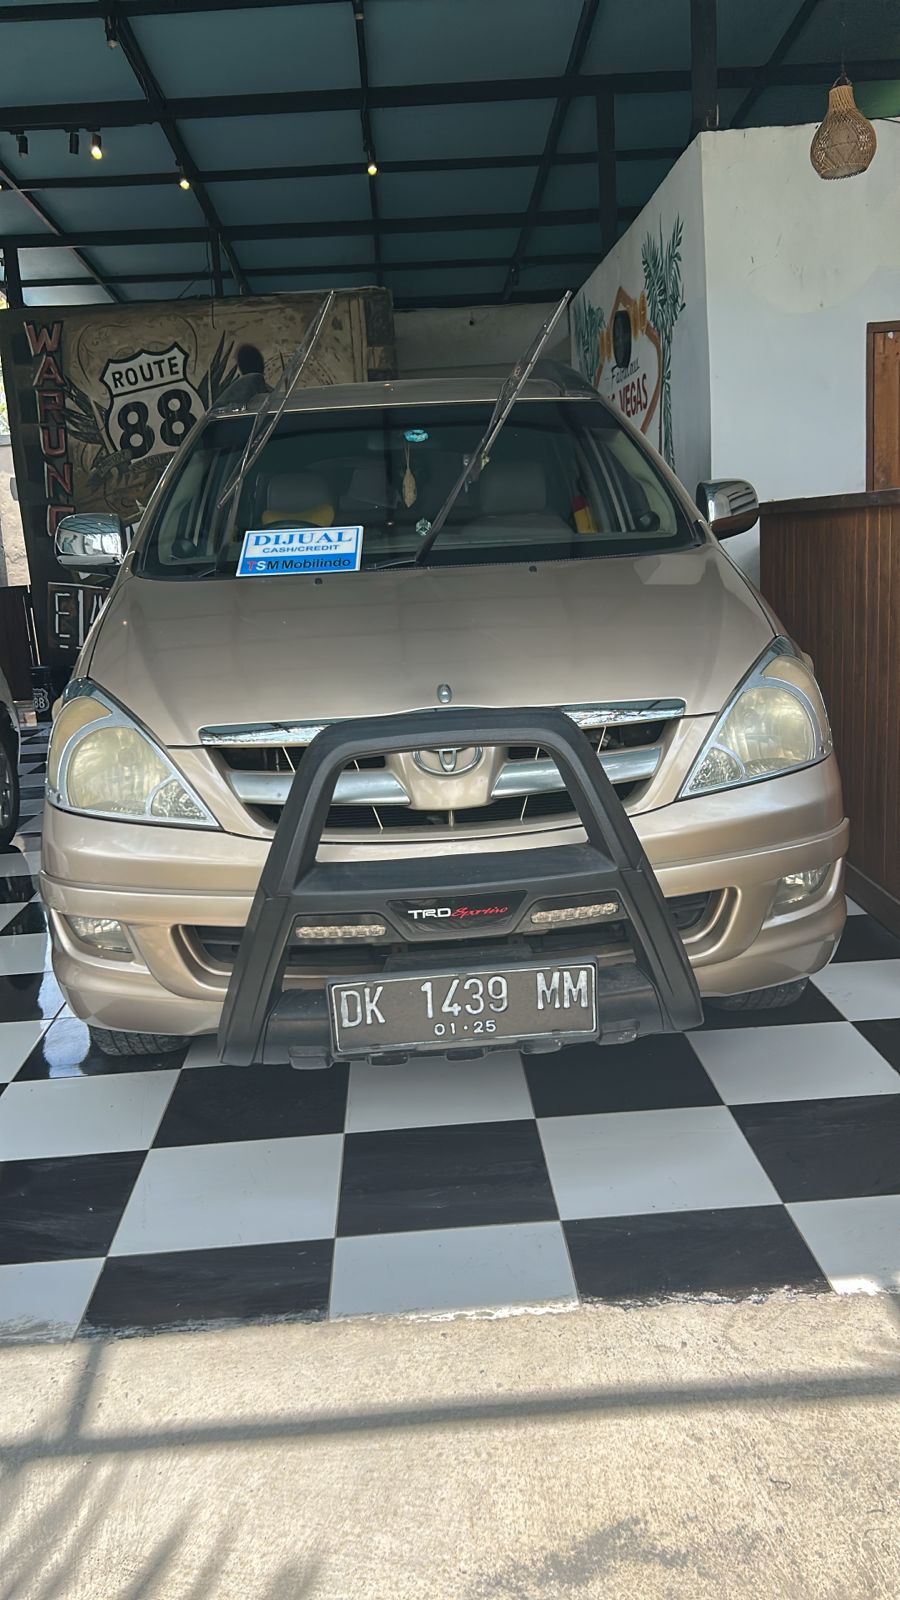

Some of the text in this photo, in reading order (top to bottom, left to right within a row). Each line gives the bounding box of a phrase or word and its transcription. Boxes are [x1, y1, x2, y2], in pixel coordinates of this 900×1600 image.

[111, 356, 180, 389] ROUTE
[619, 373, 648, 418] VEGAS
[118, 389, 198, 459] 88
[254, 532, 352, 546] DIJUAL
[262, 544, 339, 553] CASH/CREDIT
[247, 558, 351, 571] TSM Mobilindo
[407, 907, 451, 919] TRD
[340, 970, 589, 1028] DK 1439 MM
